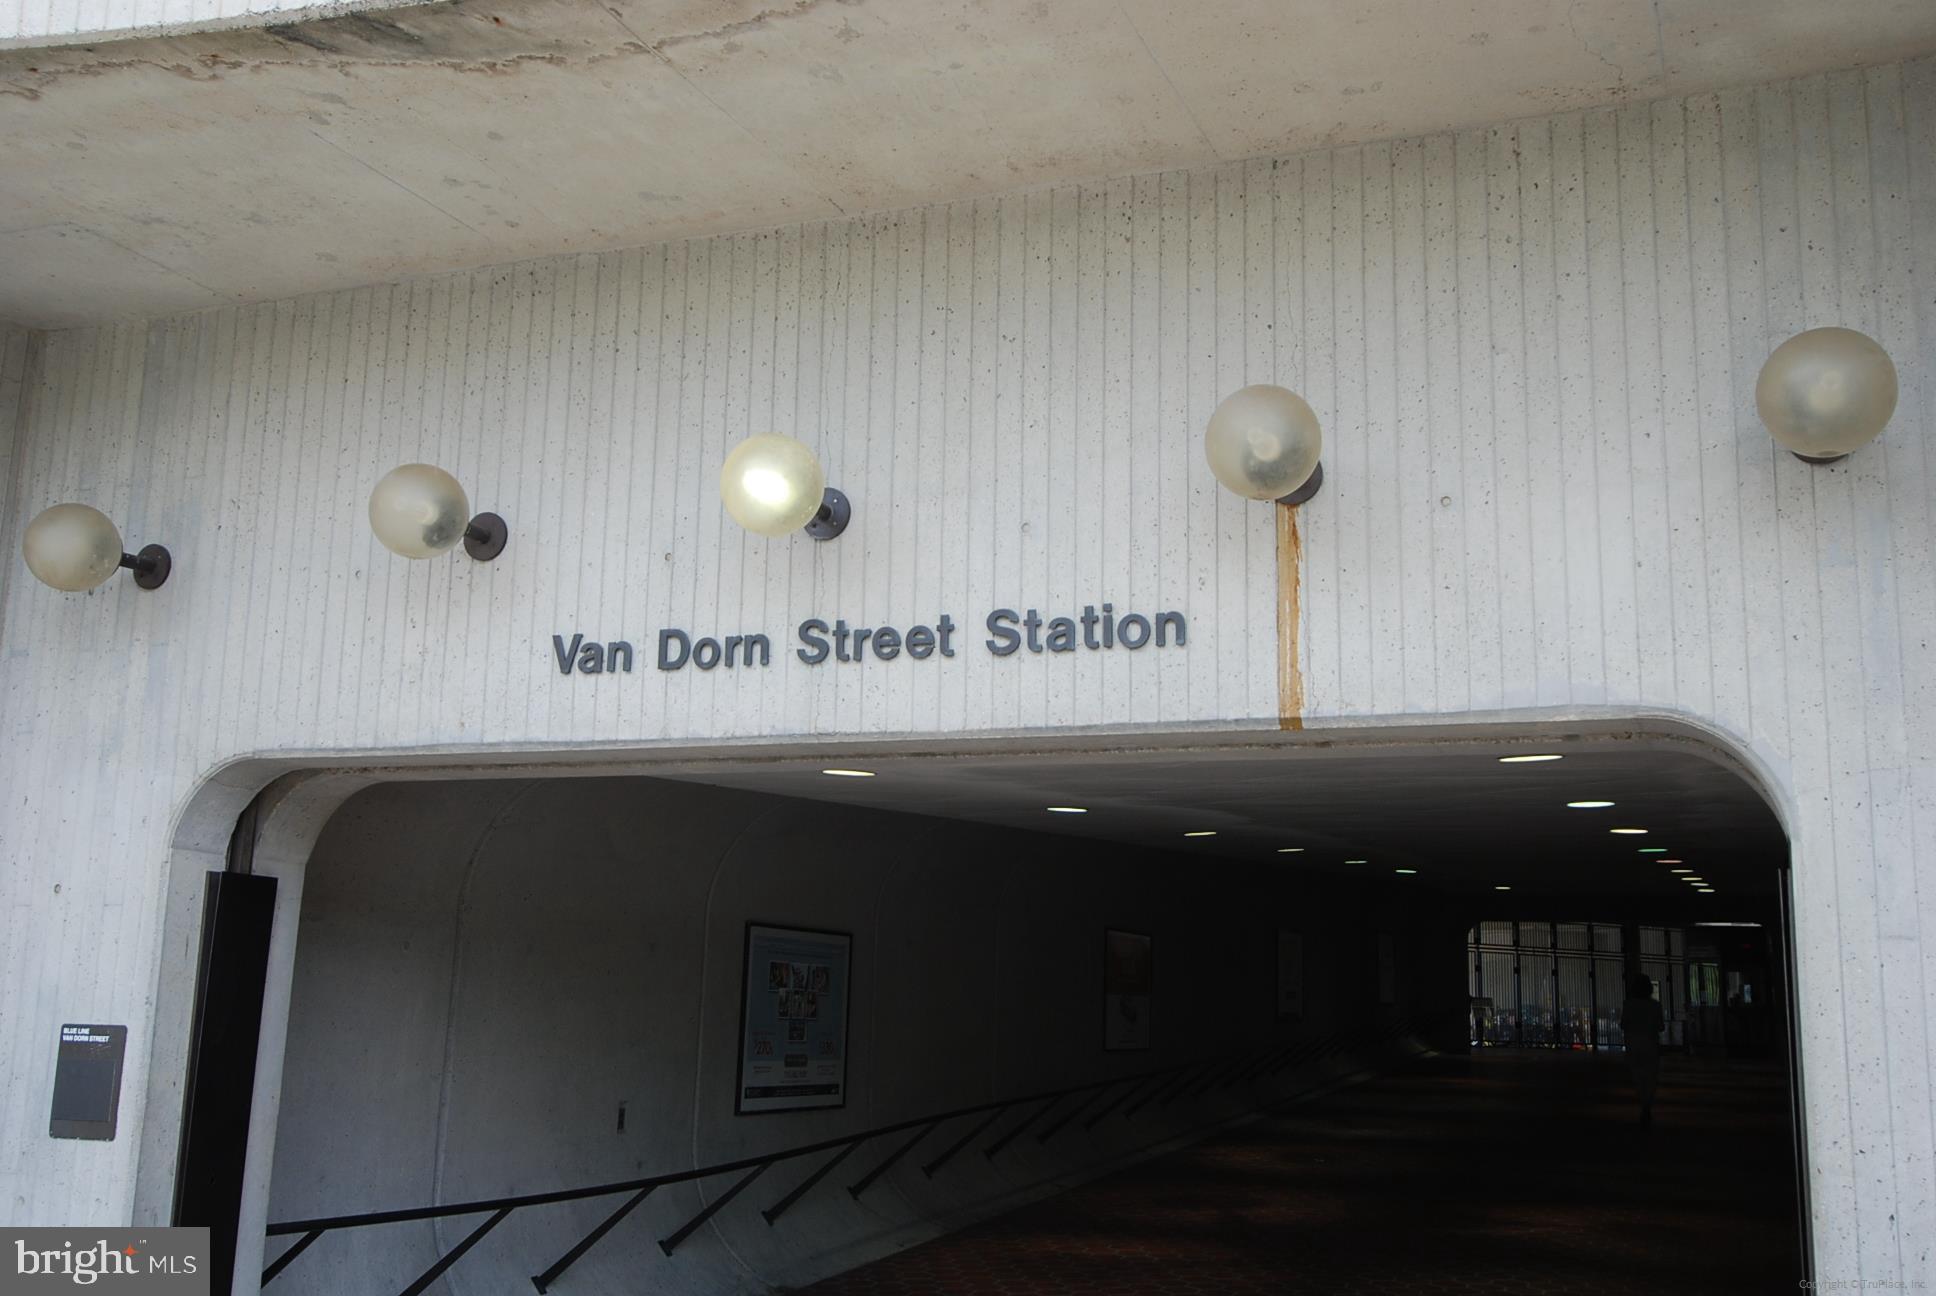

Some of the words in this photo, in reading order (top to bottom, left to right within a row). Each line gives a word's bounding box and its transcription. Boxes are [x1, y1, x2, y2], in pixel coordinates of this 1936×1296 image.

[553, 634, 633, 675] Van
[658, 629, 770, 671] Dorn
[797, 614, 956, 665] Street
[986, 603, 1187, 657] Station
